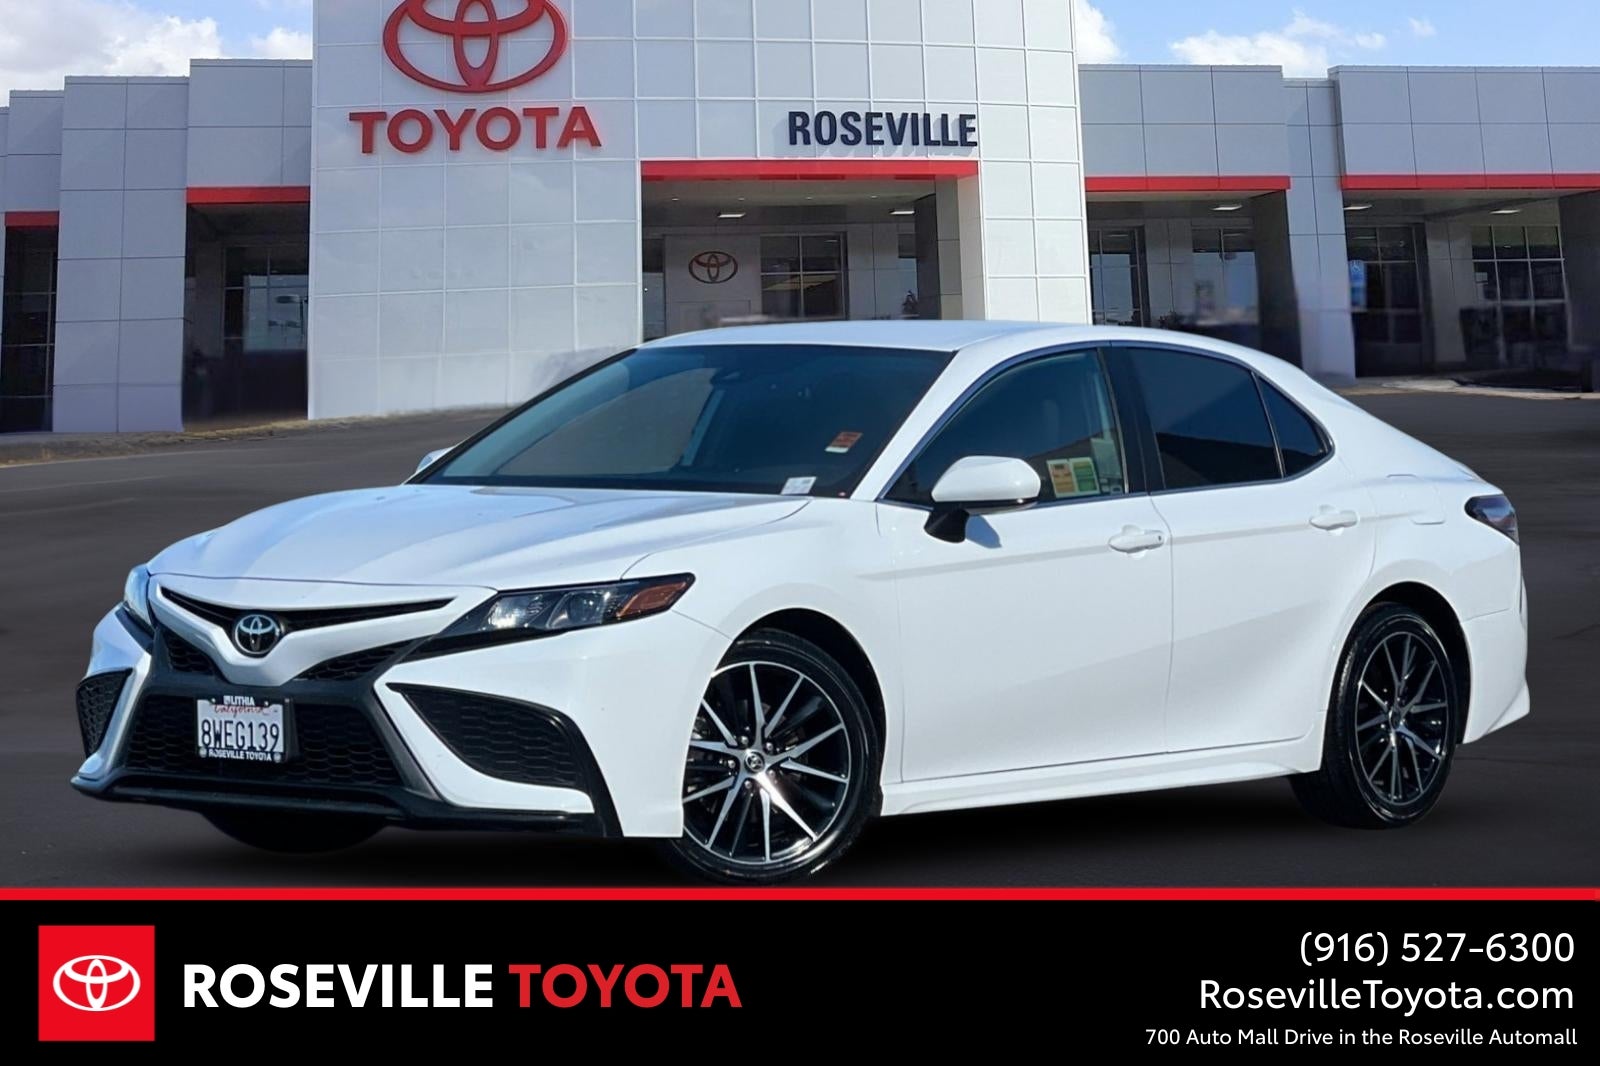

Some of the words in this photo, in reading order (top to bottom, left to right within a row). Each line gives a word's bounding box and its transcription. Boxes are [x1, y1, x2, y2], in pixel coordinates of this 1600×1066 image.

[349, 106, 602, 154] TOYOTA
[788, 110, 978, 147] ROSEVILLE
[230, 696, 255, 706] LITHIA
[201, 719, 280, 752] 8WEG139
[208, 750, 245, 760] ROSEVILLE
[246, 752, 272, 761] TOYOTA
